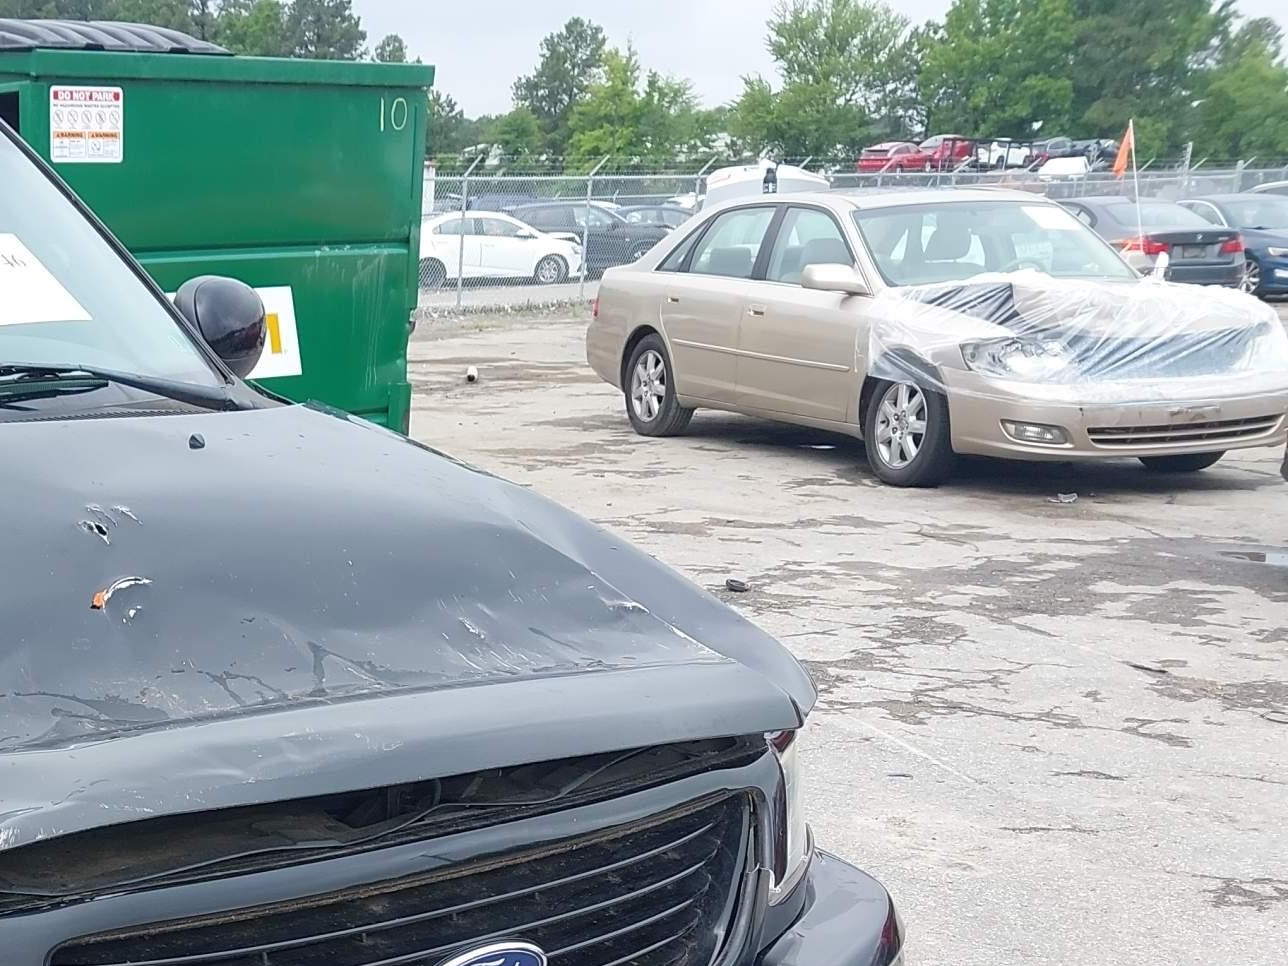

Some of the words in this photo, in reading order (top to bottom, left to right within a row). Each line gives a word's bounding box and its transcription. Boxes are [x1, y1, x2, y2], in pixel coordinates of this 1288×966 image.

[57, 90, 71, 100] DO
[73, 91, 90, 101] NOT
[92, 91, 114, 101] PARK
[380, 97, 408, 132] 10
